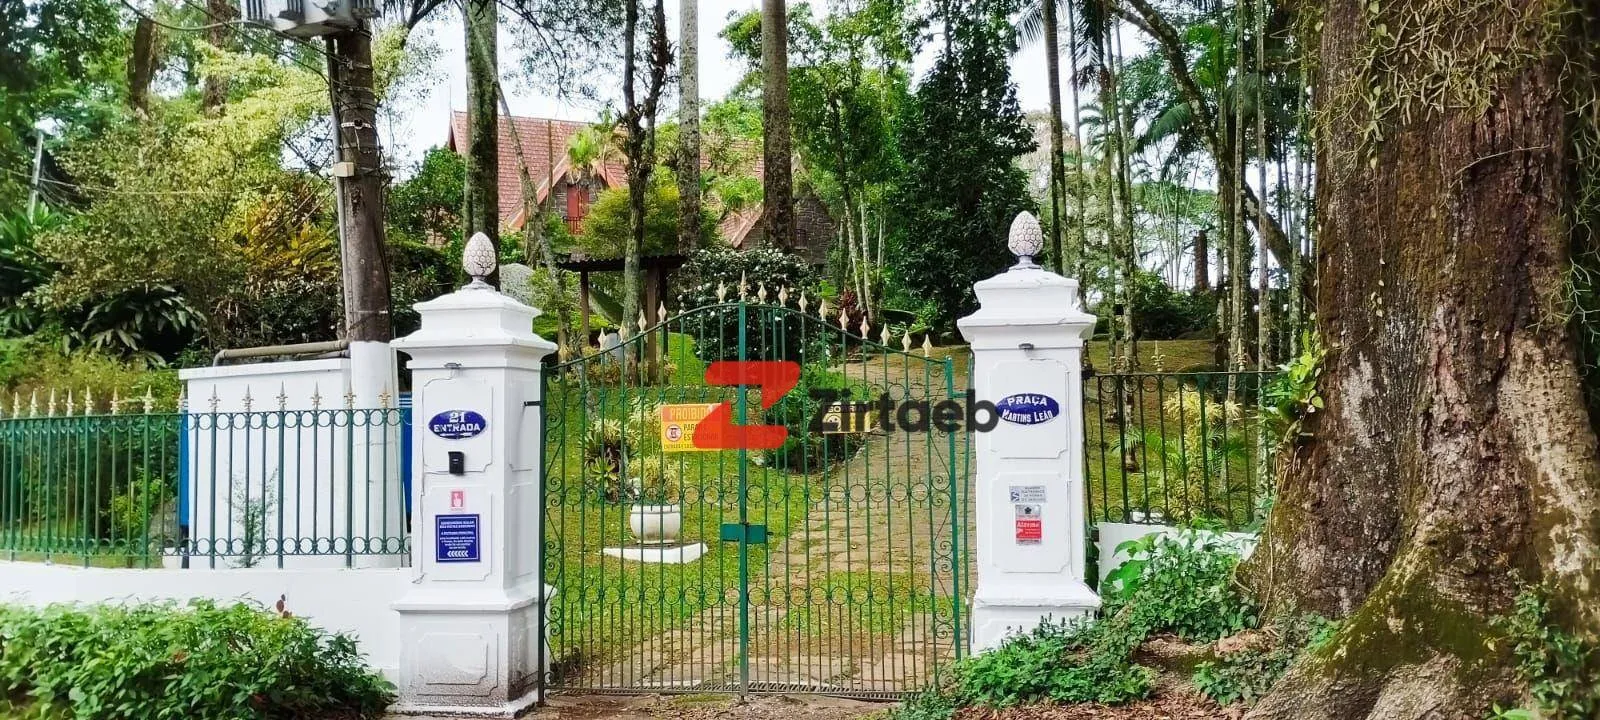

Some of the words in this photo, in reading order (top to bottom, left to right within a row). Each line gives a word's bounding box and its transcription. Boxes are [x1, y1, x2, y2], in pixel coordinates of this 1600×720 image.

[449, 411, 465, 423] 21
[1001, 409, 1032, 423] MARTINS
[433, 423, 481, 432] ENTRADA
